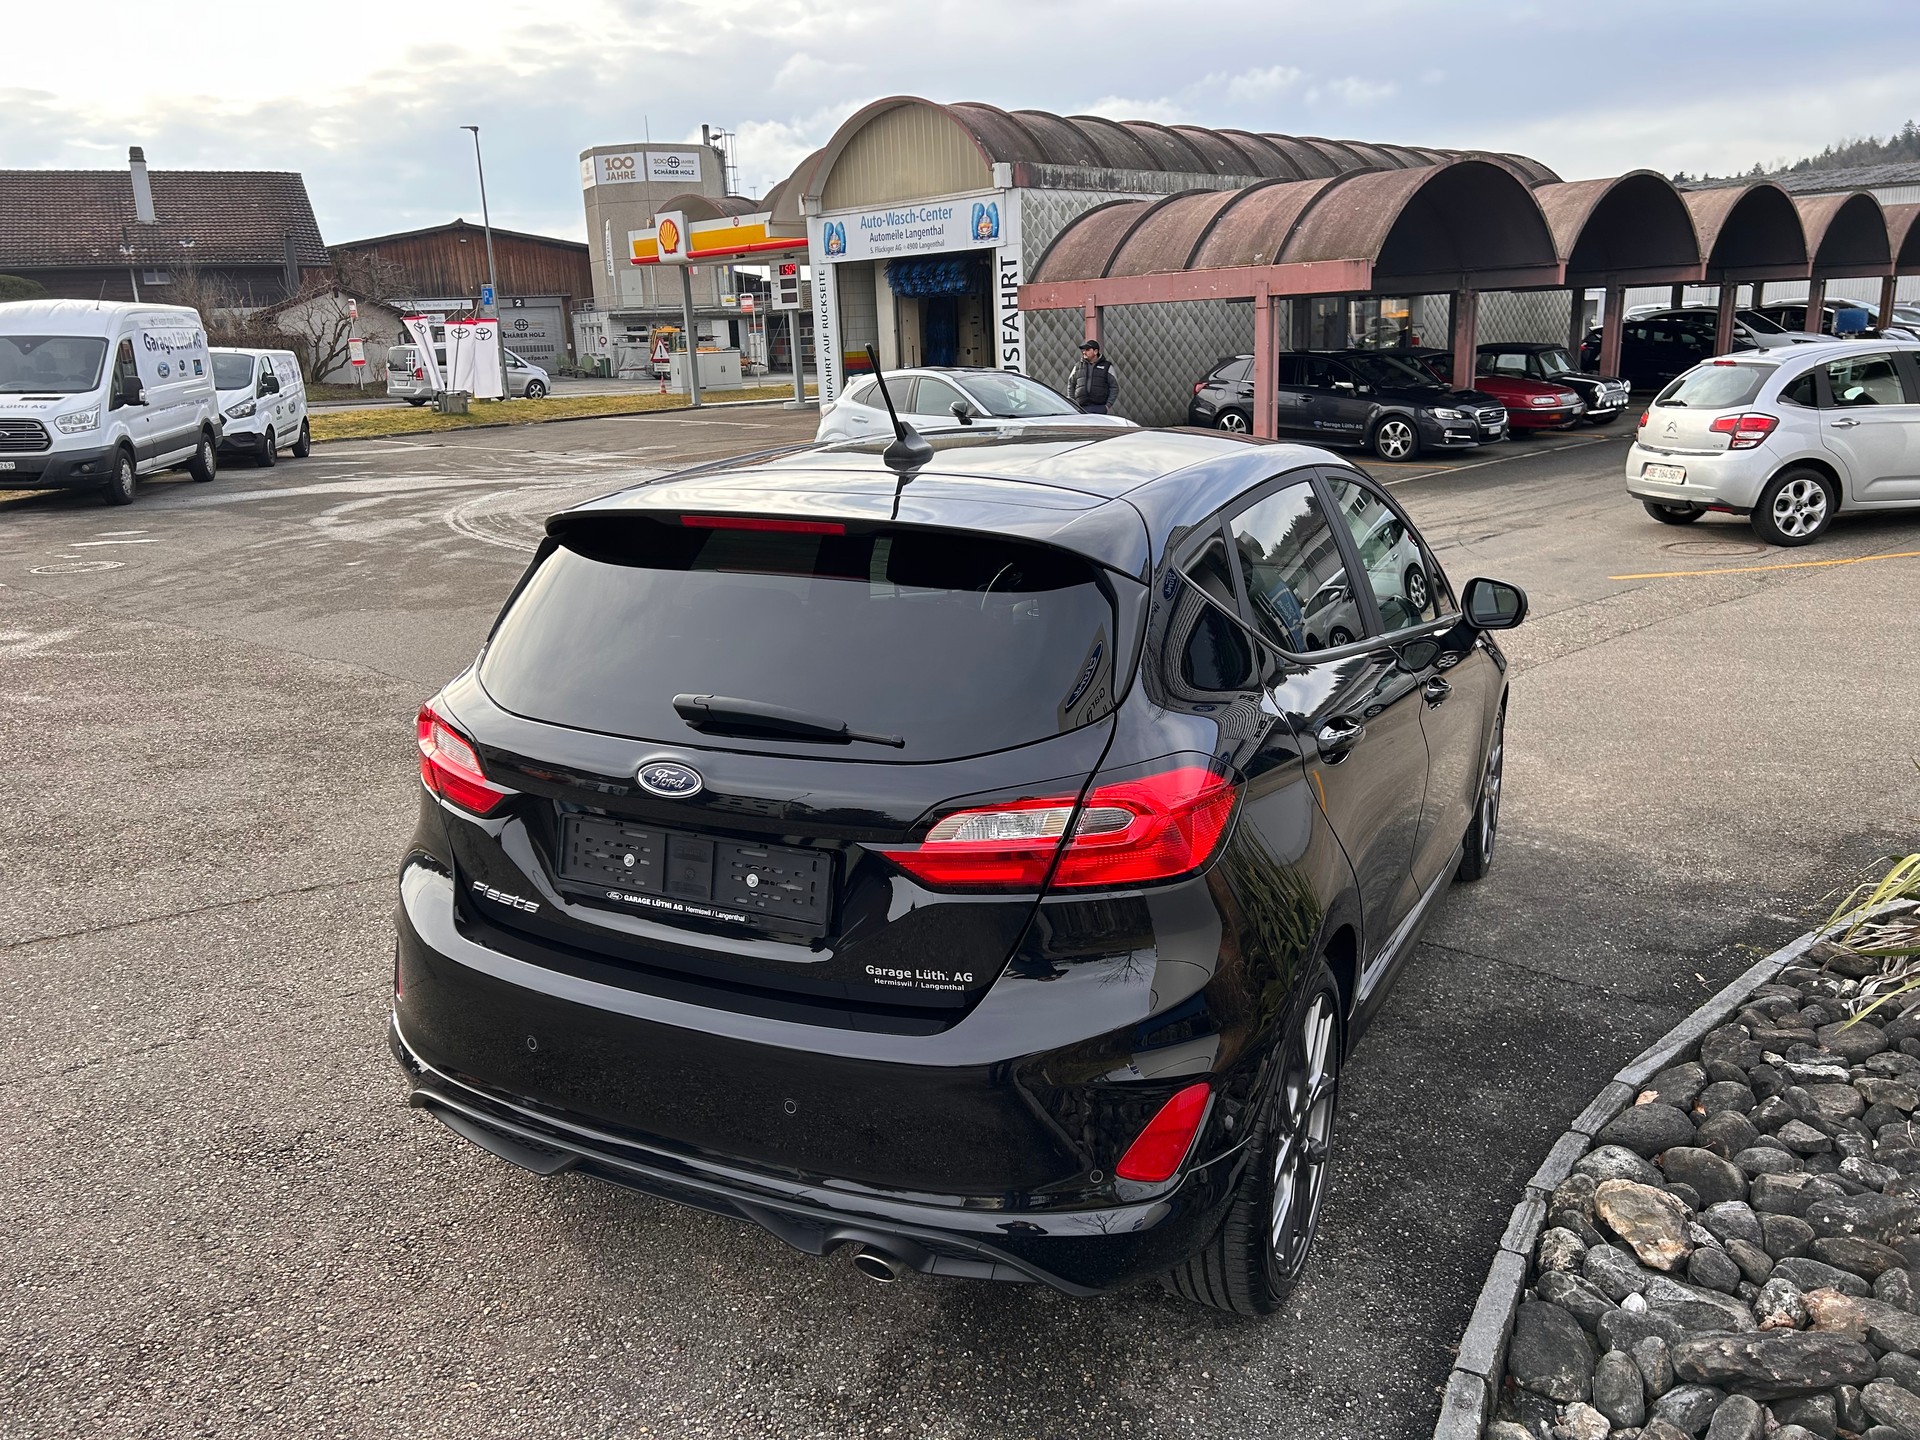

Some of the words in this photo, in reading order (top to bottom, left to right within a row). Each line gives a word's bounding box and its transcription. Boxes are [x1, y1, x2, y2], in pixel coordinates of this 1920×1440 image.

[604, 156, 635, 171] 100
[605, 170, 636, 181] JAHRE
[860, 206, 953, 229] Auto-Wasch-Center
[869, 229, 904, 243] Automeile
[905, 224, 944, 241] Langenthal
[919, 240, 945, 250] Langenthal
[515, 299, 522, 307] 2
[822, 333, 831, 354] AUF
[824, 357, 834, 404] INFAHRT
[650, 768, 687, 789] Ford
[472, 881, 540, 913] Fiesta
[623, 894, 651, 905] GARAGE
[651, 898, 672, 910] LÜTHI
[672, 903, 684, 911] AG
[685, 905, 711, 916] Hermiswil
[715, 910, 746, 922] Langenthal
[865, 964, 911, 978] Garage
[953, 972, 973, 982] AG
[874, 978, 912, 987] Hermiswil
[920, 982, 965, 991] Langenthal
